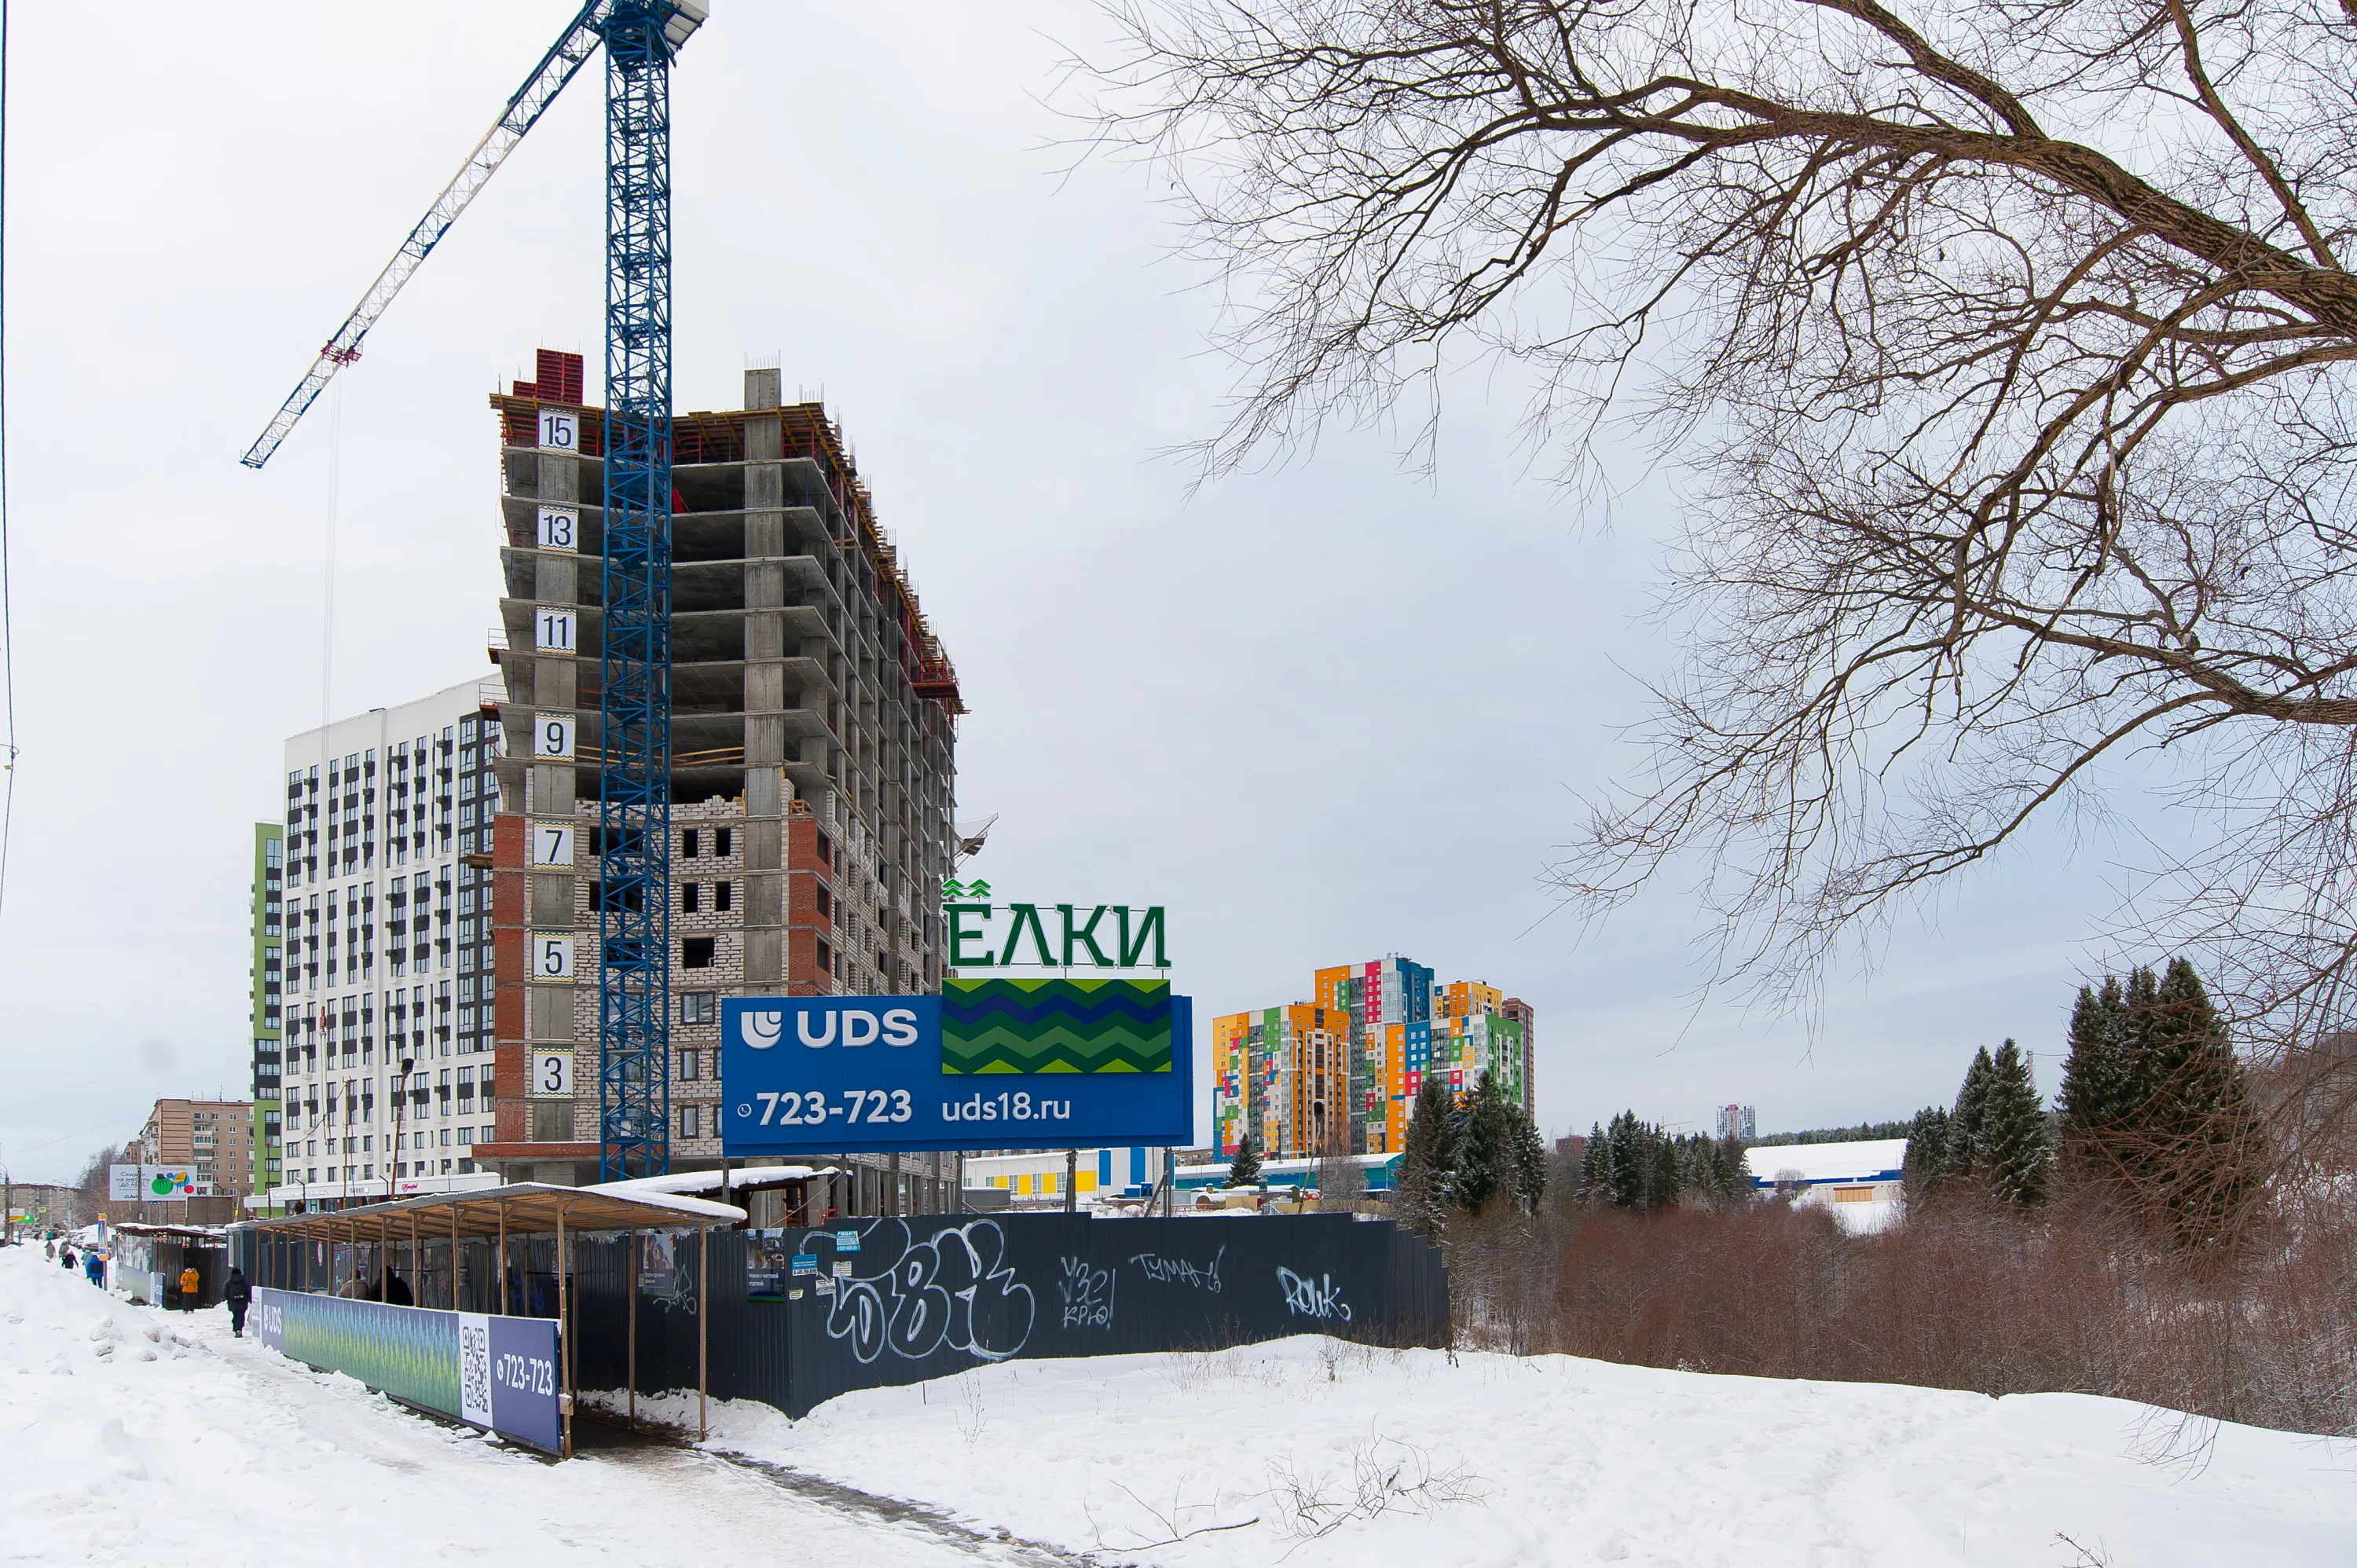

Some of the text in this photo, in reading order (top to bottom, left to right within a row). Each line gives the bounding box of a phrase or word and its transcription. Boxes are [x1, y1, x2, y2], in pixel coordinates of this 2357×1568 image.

[544, 416, 572, 447] 15
[543, 515, 571, 547] 13
[543, 615, 567, 648] 11
[545, 722, 565, 753] 9
[544, 830, 563, 863] 7
[942, 878, 1172, 969] ЁЛКИ
[544, 940, 563, 975] 5
[797, 1009, 918, 1049] UDS
[544, 1056, 563, 1093] 3
[757, 1089, 1071, 1127] 723-723 uds18.ru
[269, 1305, 282, 1335] UDS
[504, 1353, 553, 1397] 723-723
